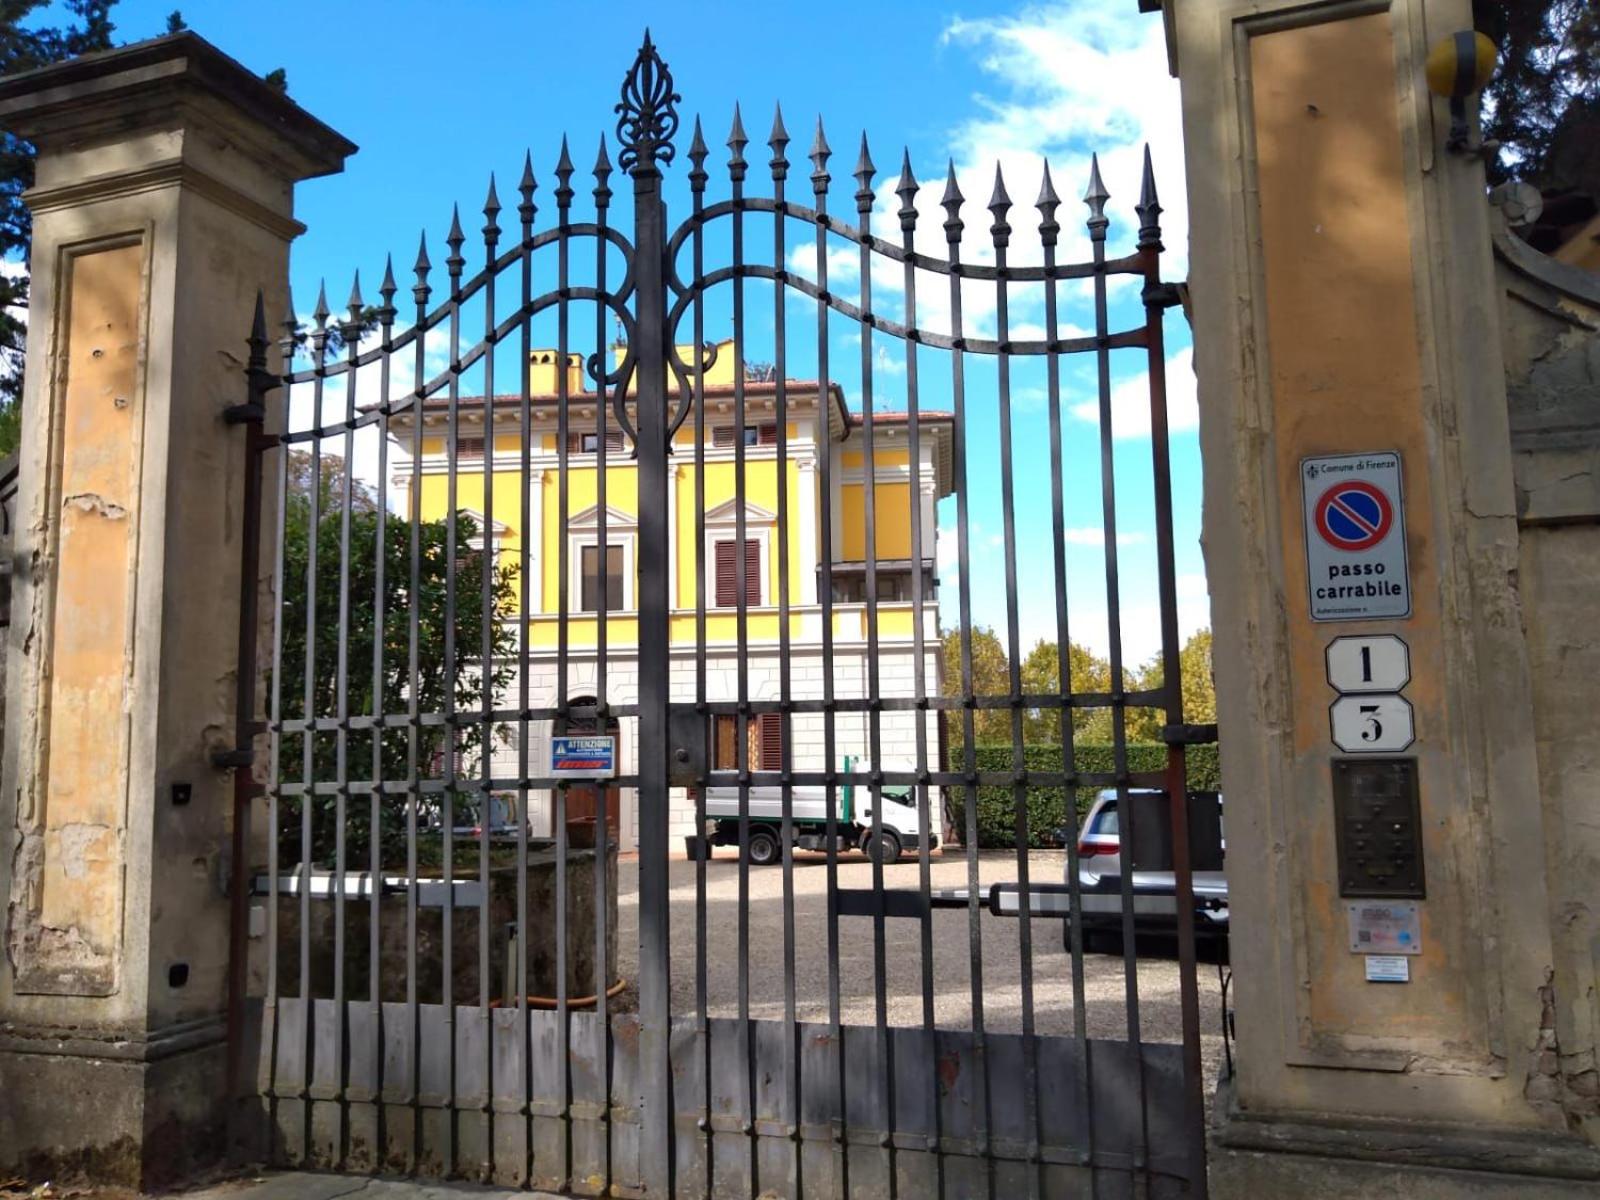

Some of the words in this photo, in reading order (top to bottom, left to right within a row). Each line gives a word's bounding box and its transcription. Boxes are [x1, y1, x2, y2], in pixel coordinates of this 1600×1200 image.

[1321, 464, 1354, 473] Comune
[1356, 460, 1365, 470] di
[1366, 460, 1396, 470] Firenze
[1329, 563, 1385, 580] passo
[1316, 581, 1402, 599] carrabile
[1360, 646, 1372, 682] 1
[1360, 705, 1382, 742] 3
[567, 739, 611, 749] ATTENZIONE
